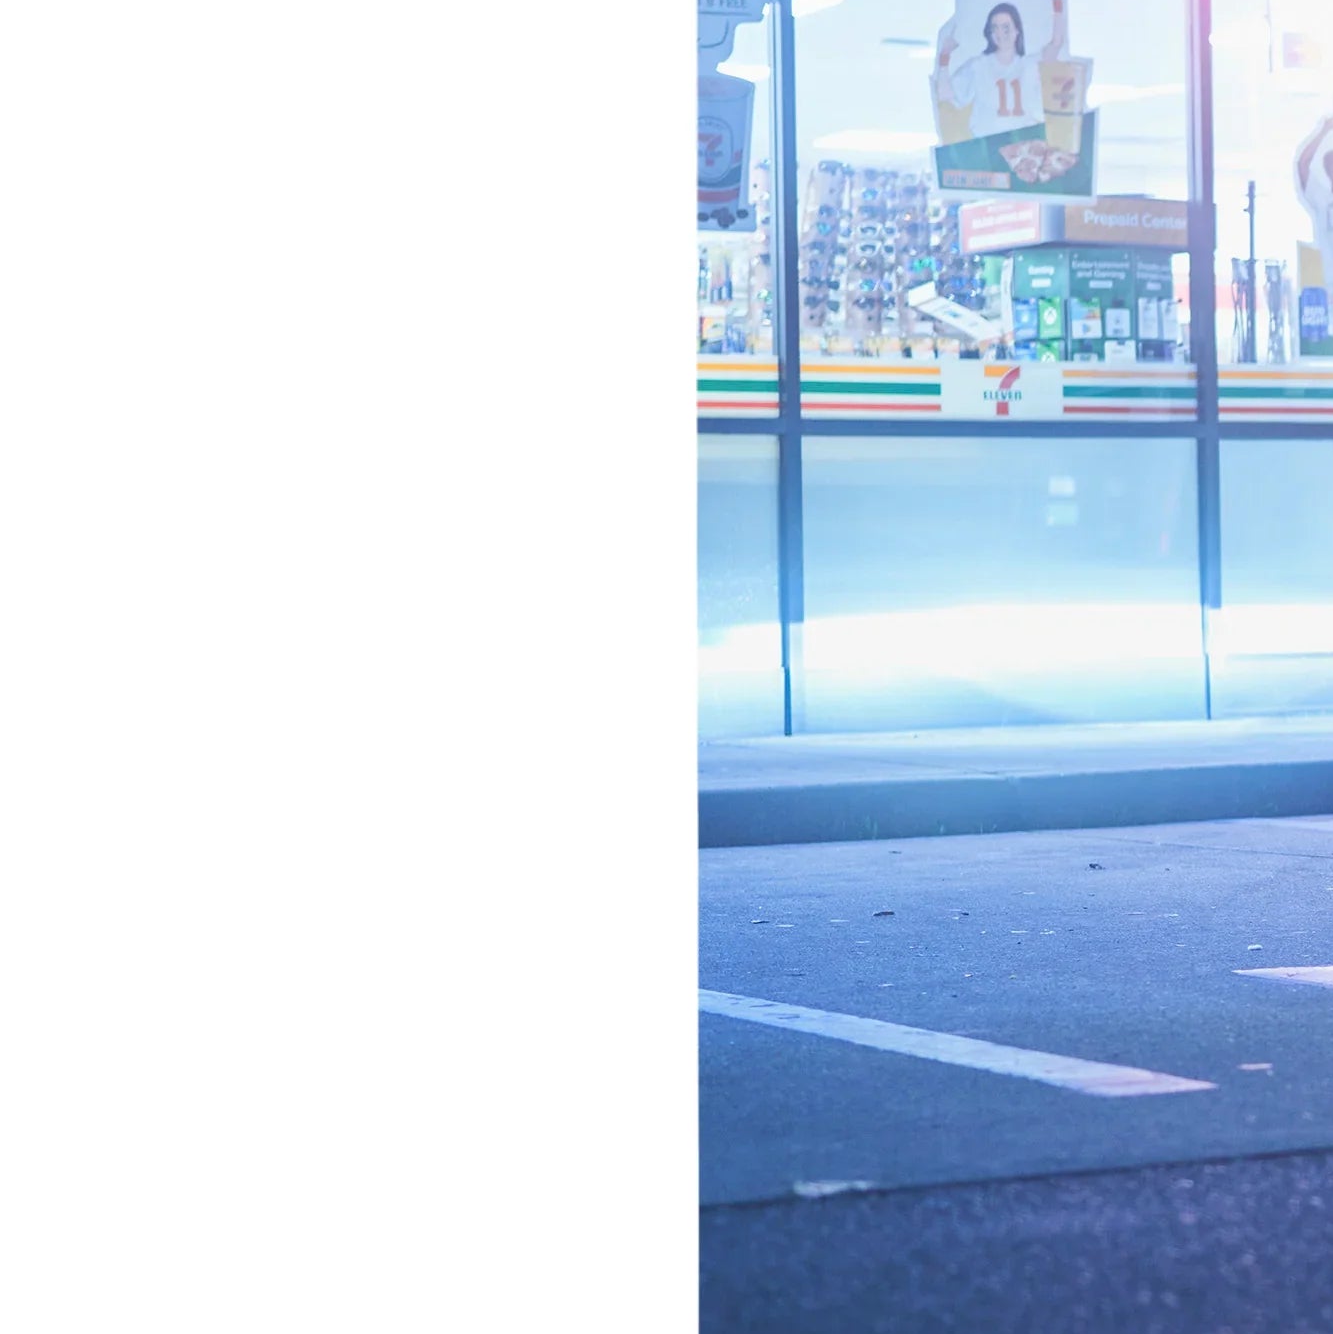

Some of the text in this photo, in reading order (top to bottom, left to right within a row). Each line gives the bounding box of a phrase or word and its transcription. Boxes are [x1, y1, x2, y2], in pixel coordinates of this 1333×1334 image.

[995, 78, 1025, 117] 11
[1083, 210, 1139, 227] Prepaid
[983, 365, 1021, 416] 7
